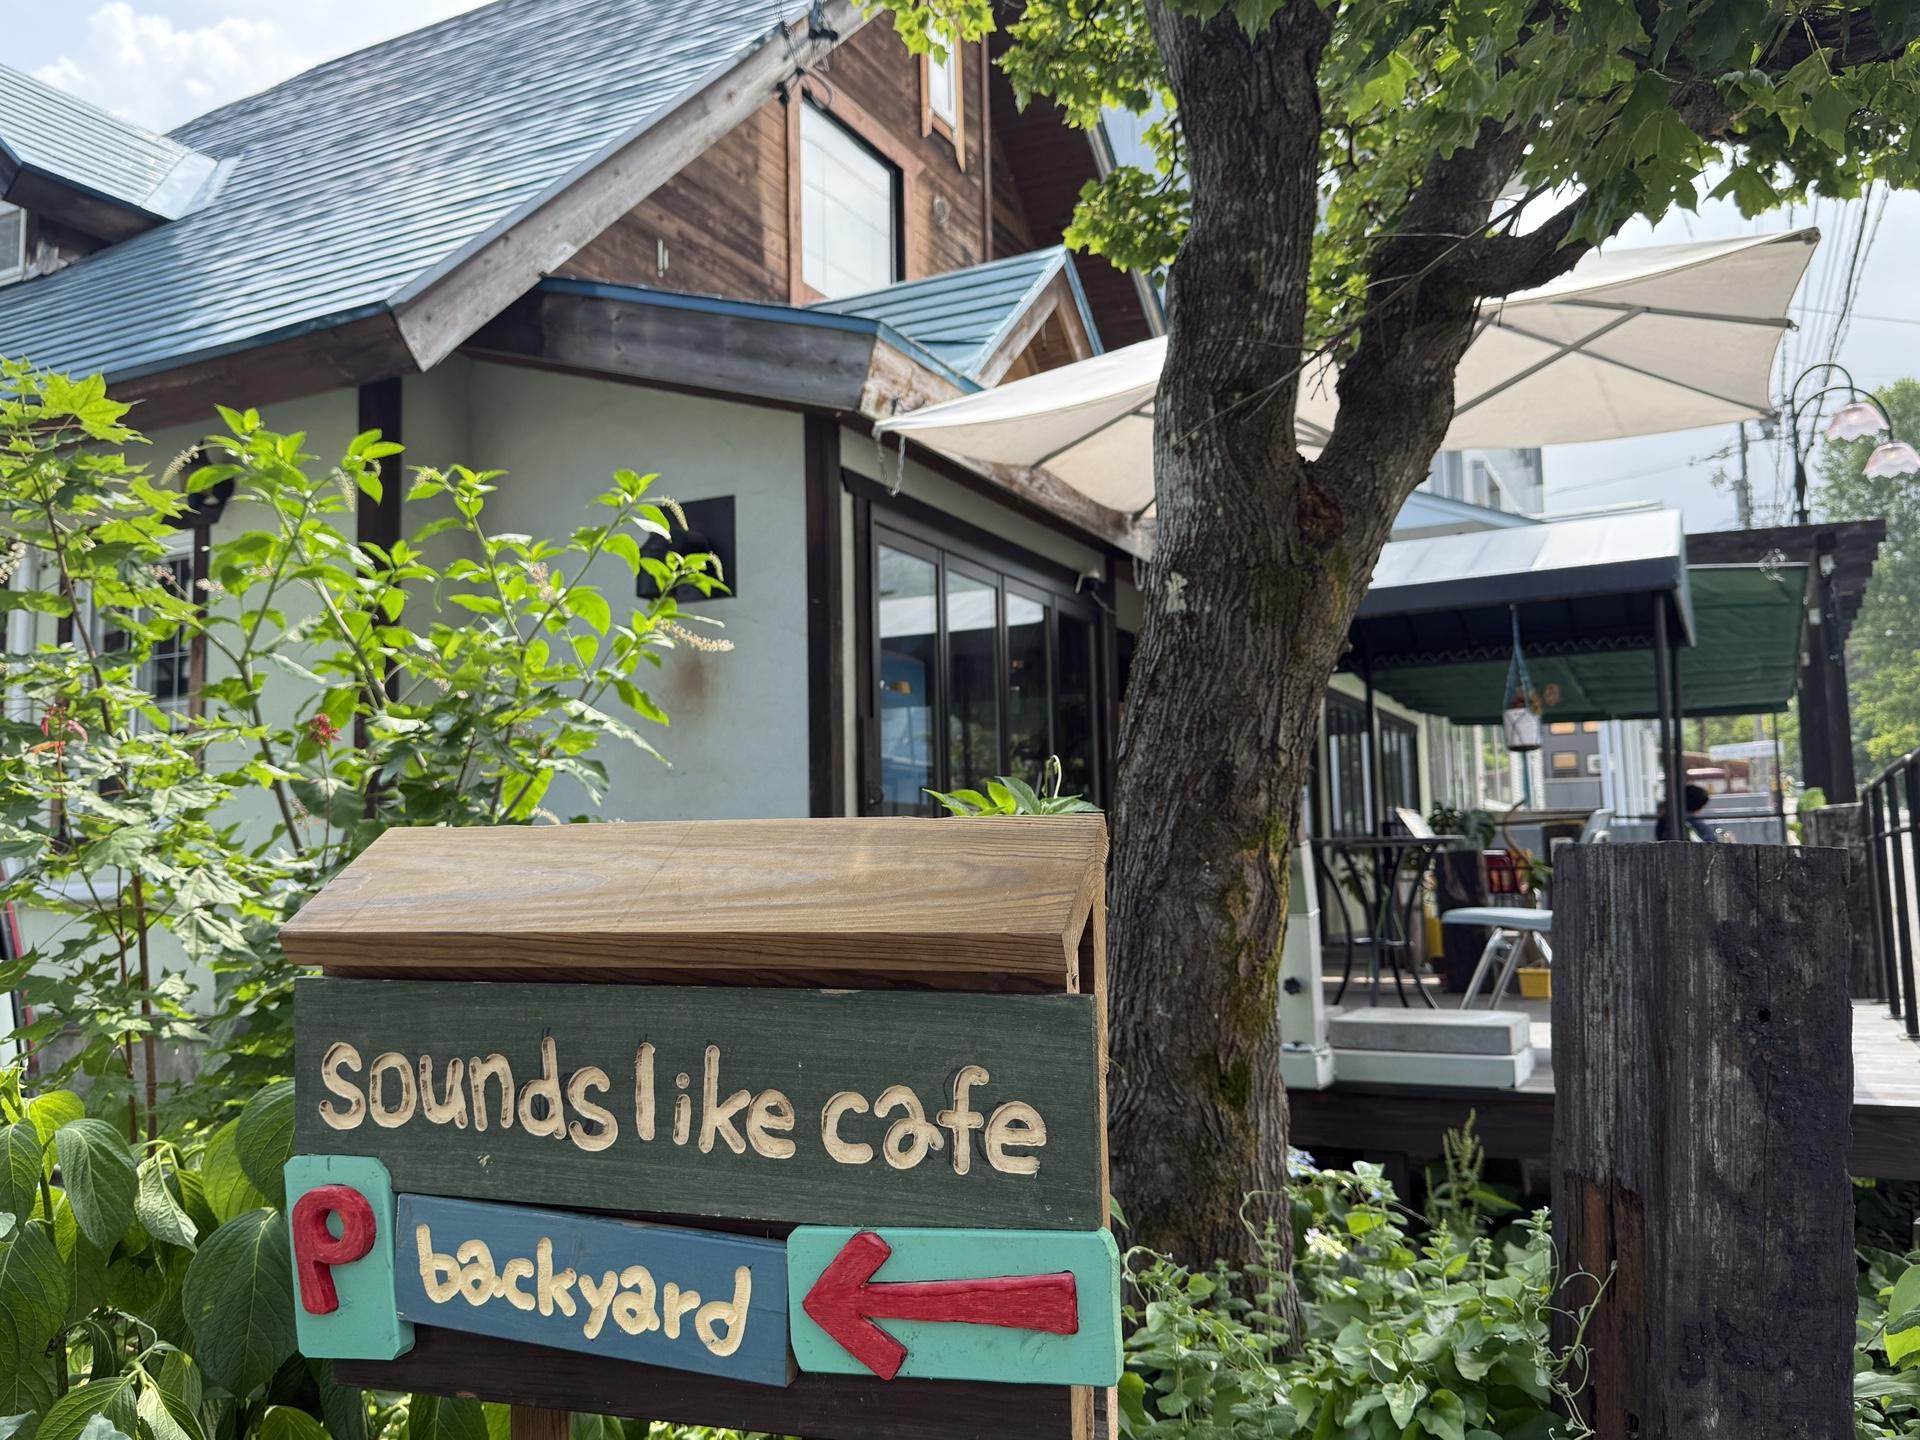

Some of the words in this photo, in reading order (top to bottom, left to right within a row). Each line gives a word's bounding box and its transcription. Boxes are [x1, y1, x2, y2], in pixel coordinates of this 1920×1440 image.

[636, 1042, 797, 1159] like
[822, 1065, 1047, 1176] cafe
[291, 1184, 376, 1315] P
[416, 1223, 752, 1357] backyard
